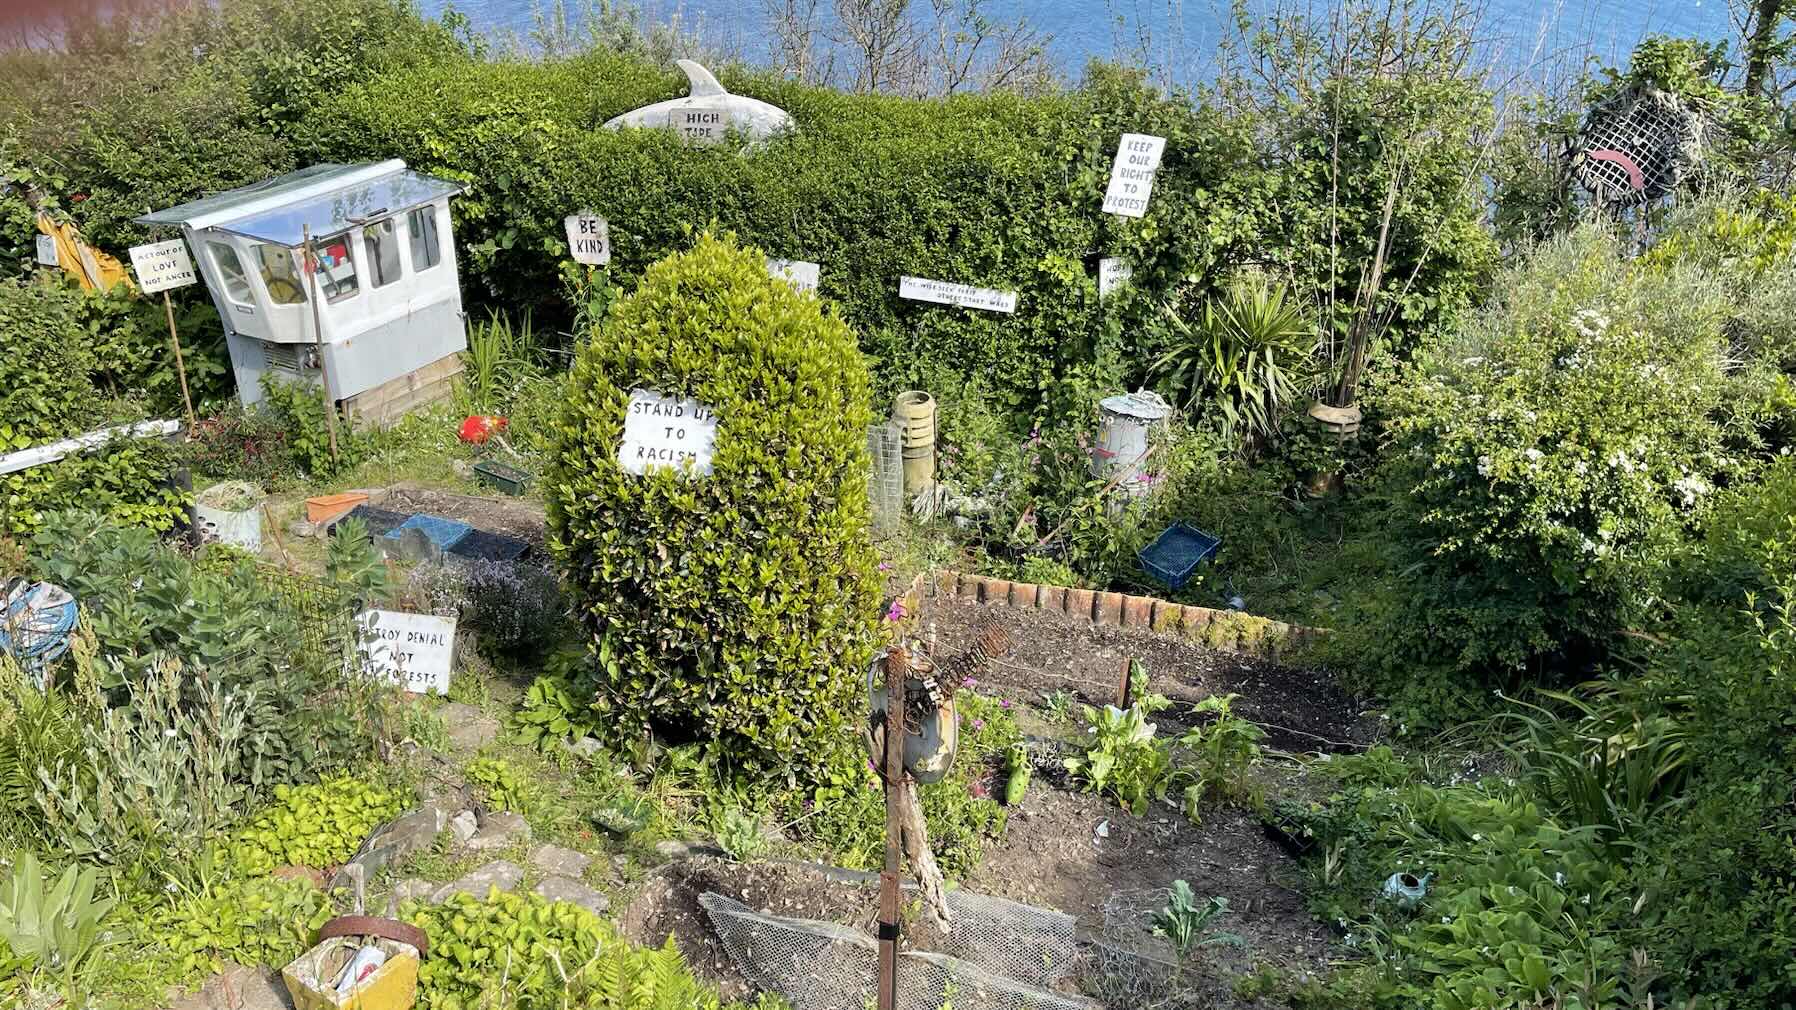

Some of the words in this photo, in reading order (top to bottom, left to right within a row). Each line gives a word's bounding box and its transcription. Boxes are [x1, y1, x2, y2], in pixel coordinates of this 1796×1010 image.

[686, 113, 719, 123] HIGH
[1127, 139, 1153, 152] KEEP
[1128, 154, 1151, 166] OUR
[1120, 167, 1153, 181] RIGHT
[1123, 183, 1138, 193] TO
[1106, 195, 1146, 211] PROTEST
[579, 219, 597, 234] BE
[172, 246, 183, 254] OF
[577, 239, 603, 253] KIND
[152, 260, 177, 272] LOVE
[145, 277, 161, 286] NOT
[166, 271, 192, 281] ANGER
[633, 402, 684, 418] STAND
[694, 408, 713, 421] UP
[664, 427, 686, 440] TO
[407, 631, 445, 647] DENIAL
[389, 650, 414, 662] NOT
